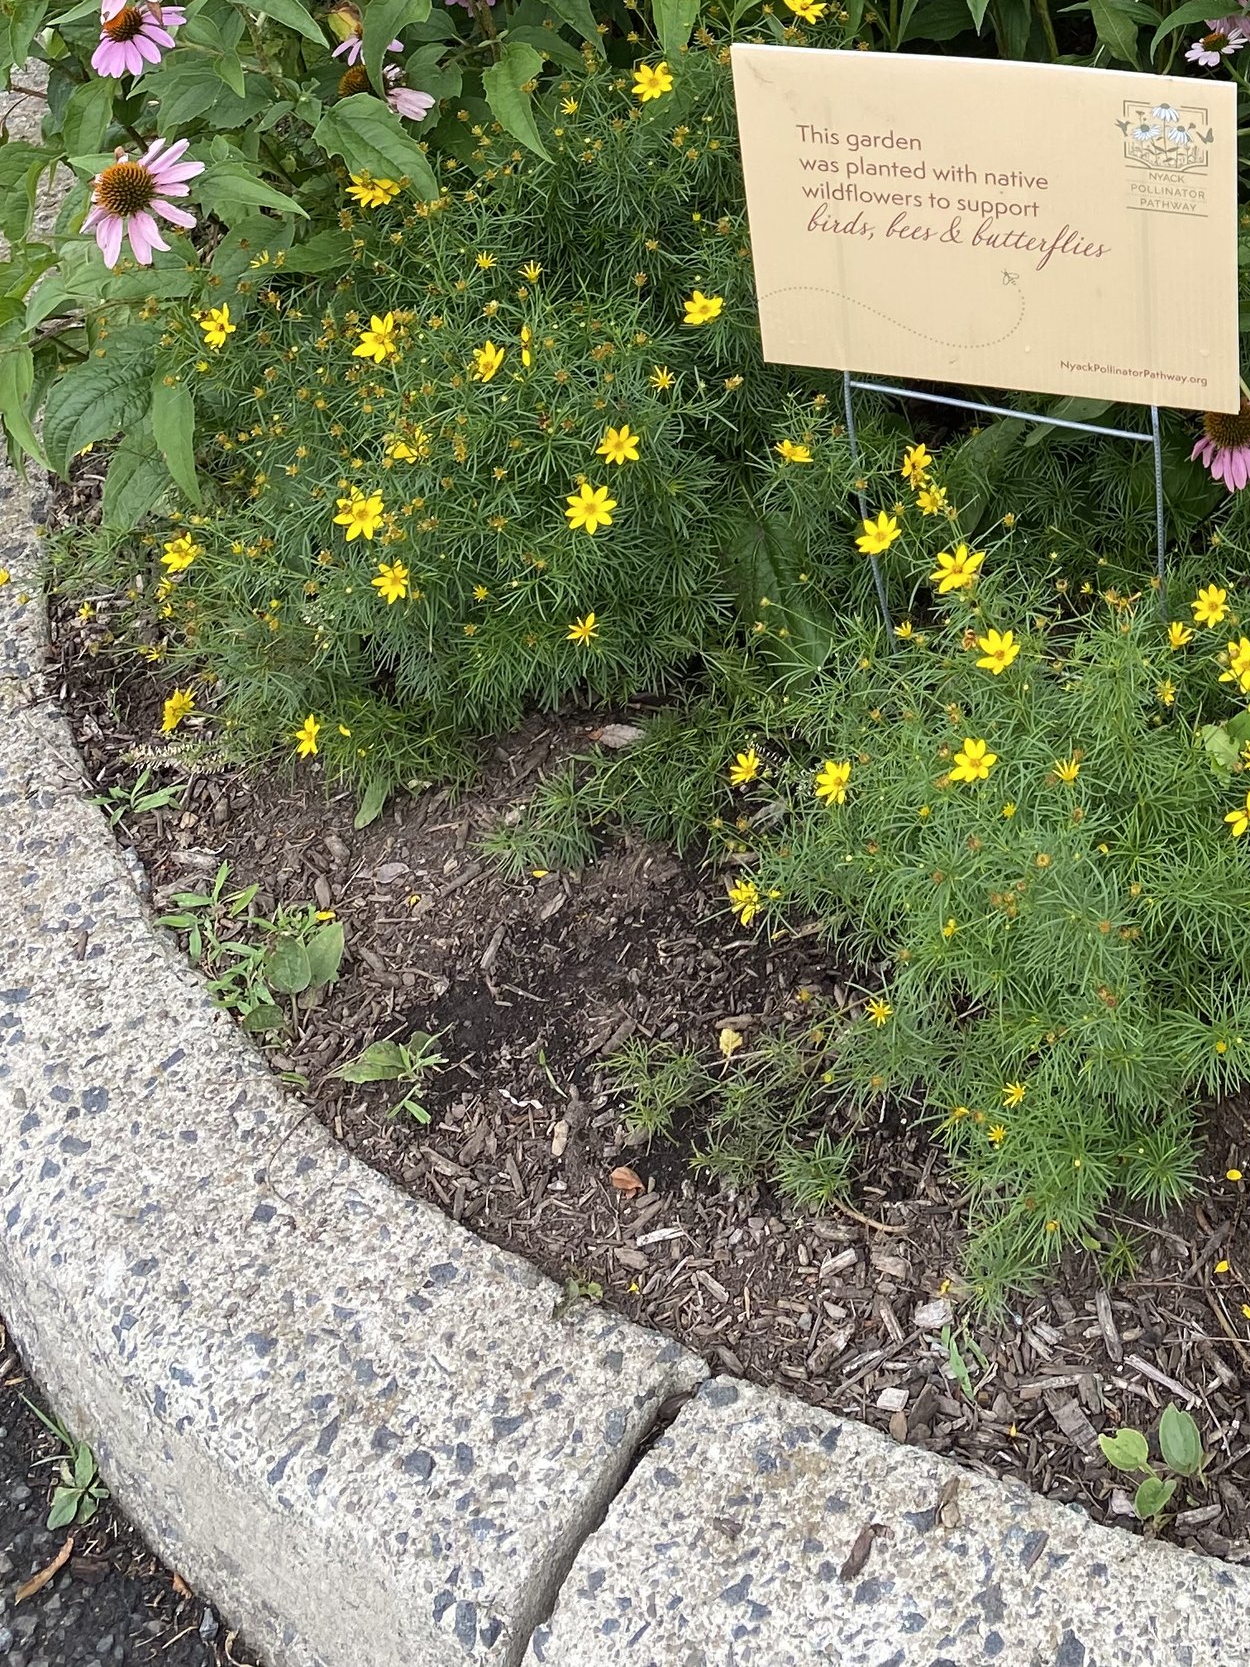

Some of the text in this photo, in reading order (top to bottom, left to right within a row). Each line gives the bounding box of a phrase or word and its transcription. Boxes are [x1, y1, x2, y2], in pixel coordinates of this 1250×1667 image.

[796, 124, 922, 152] This garden
[799, 156, 1049, 190] was planted with native
[1148, 172, 1186, 184] NYACK
[802, 181, 1040, 220] wildflowers to support
[1130, 183, 1206, 200] POLLINATOR
[1140, 198, 1197, 212] PATHWAY
[807, 202, 1111, 271] birds, bees & butterflies
[1060, 360, 1208, 387] NyackPollinatorPathway.org
